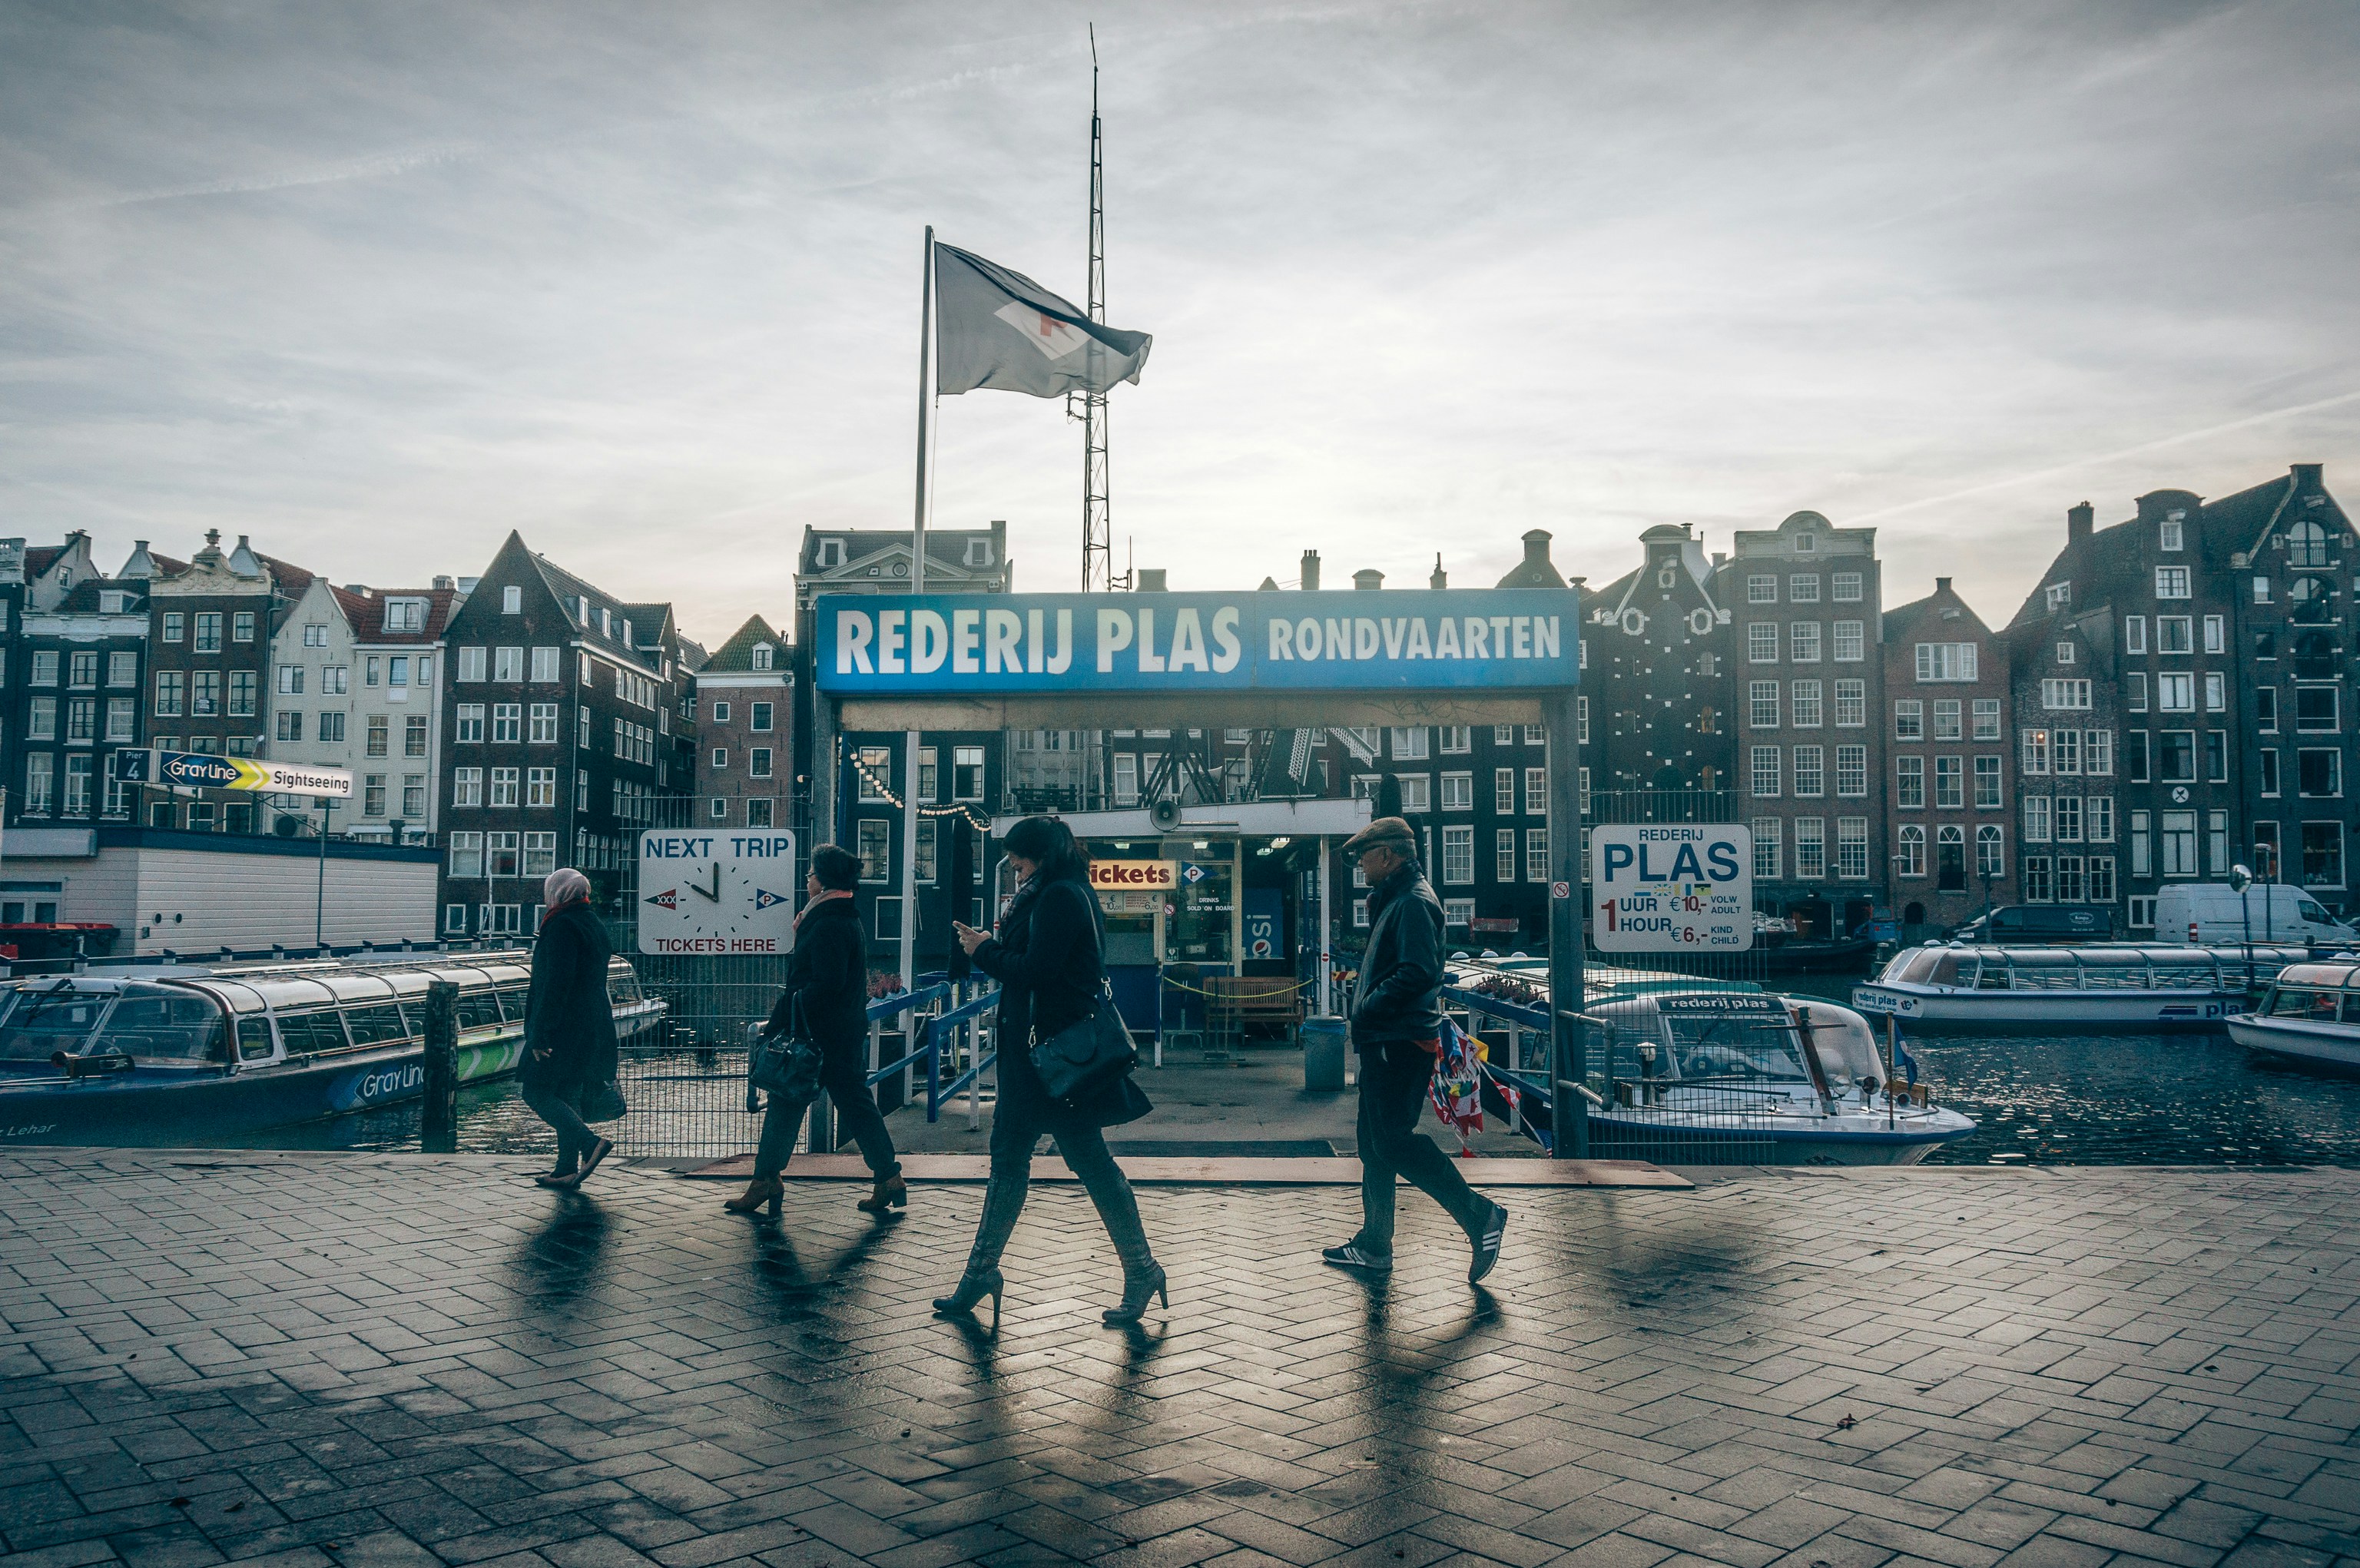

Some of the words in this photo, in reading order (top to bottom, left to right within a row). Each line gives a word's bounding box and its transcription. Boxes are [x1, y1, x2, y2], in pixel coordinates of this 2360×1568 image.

[836, 609, 1072, 675] REDERIJ
[1096, 606, 1241, 674] PLAS
[1268, 616, 1560, 661] RONDVAARTEN
[127, 761, 139, 779] 4
[273, 771, 349, 793] Sightseeing
[1639, 829, 1704, 841] REDERIJ
[646, 838, 714, 858] NEXT
[730, 837, 789, 857] TRIP
[1603, 841, 1739, 883] PLAS
[1091, 864, 1171, 883] ickets
[764, 895, 771, 905] P
[1620, 897, 1658, 912] UUR
[1711, 895, 1737, 903] VOLW
[1601, 899, 1616, 932] 1
[1711, 906, 1741, 914] ADULT
[1620, 917, 1672, 932] HOUR
[656, 938, 726, 952] TICKETS
[731, 938, 776, 952] HERE
[1670, 998, 1730, 1009] rederij
[1732, 998, 1769, 1009] plas
[1858, 992, 1877, 1005] rederij
[1878, 996, 1898, 1006] plas
[7, 1124, 57, 1136] Lehar
